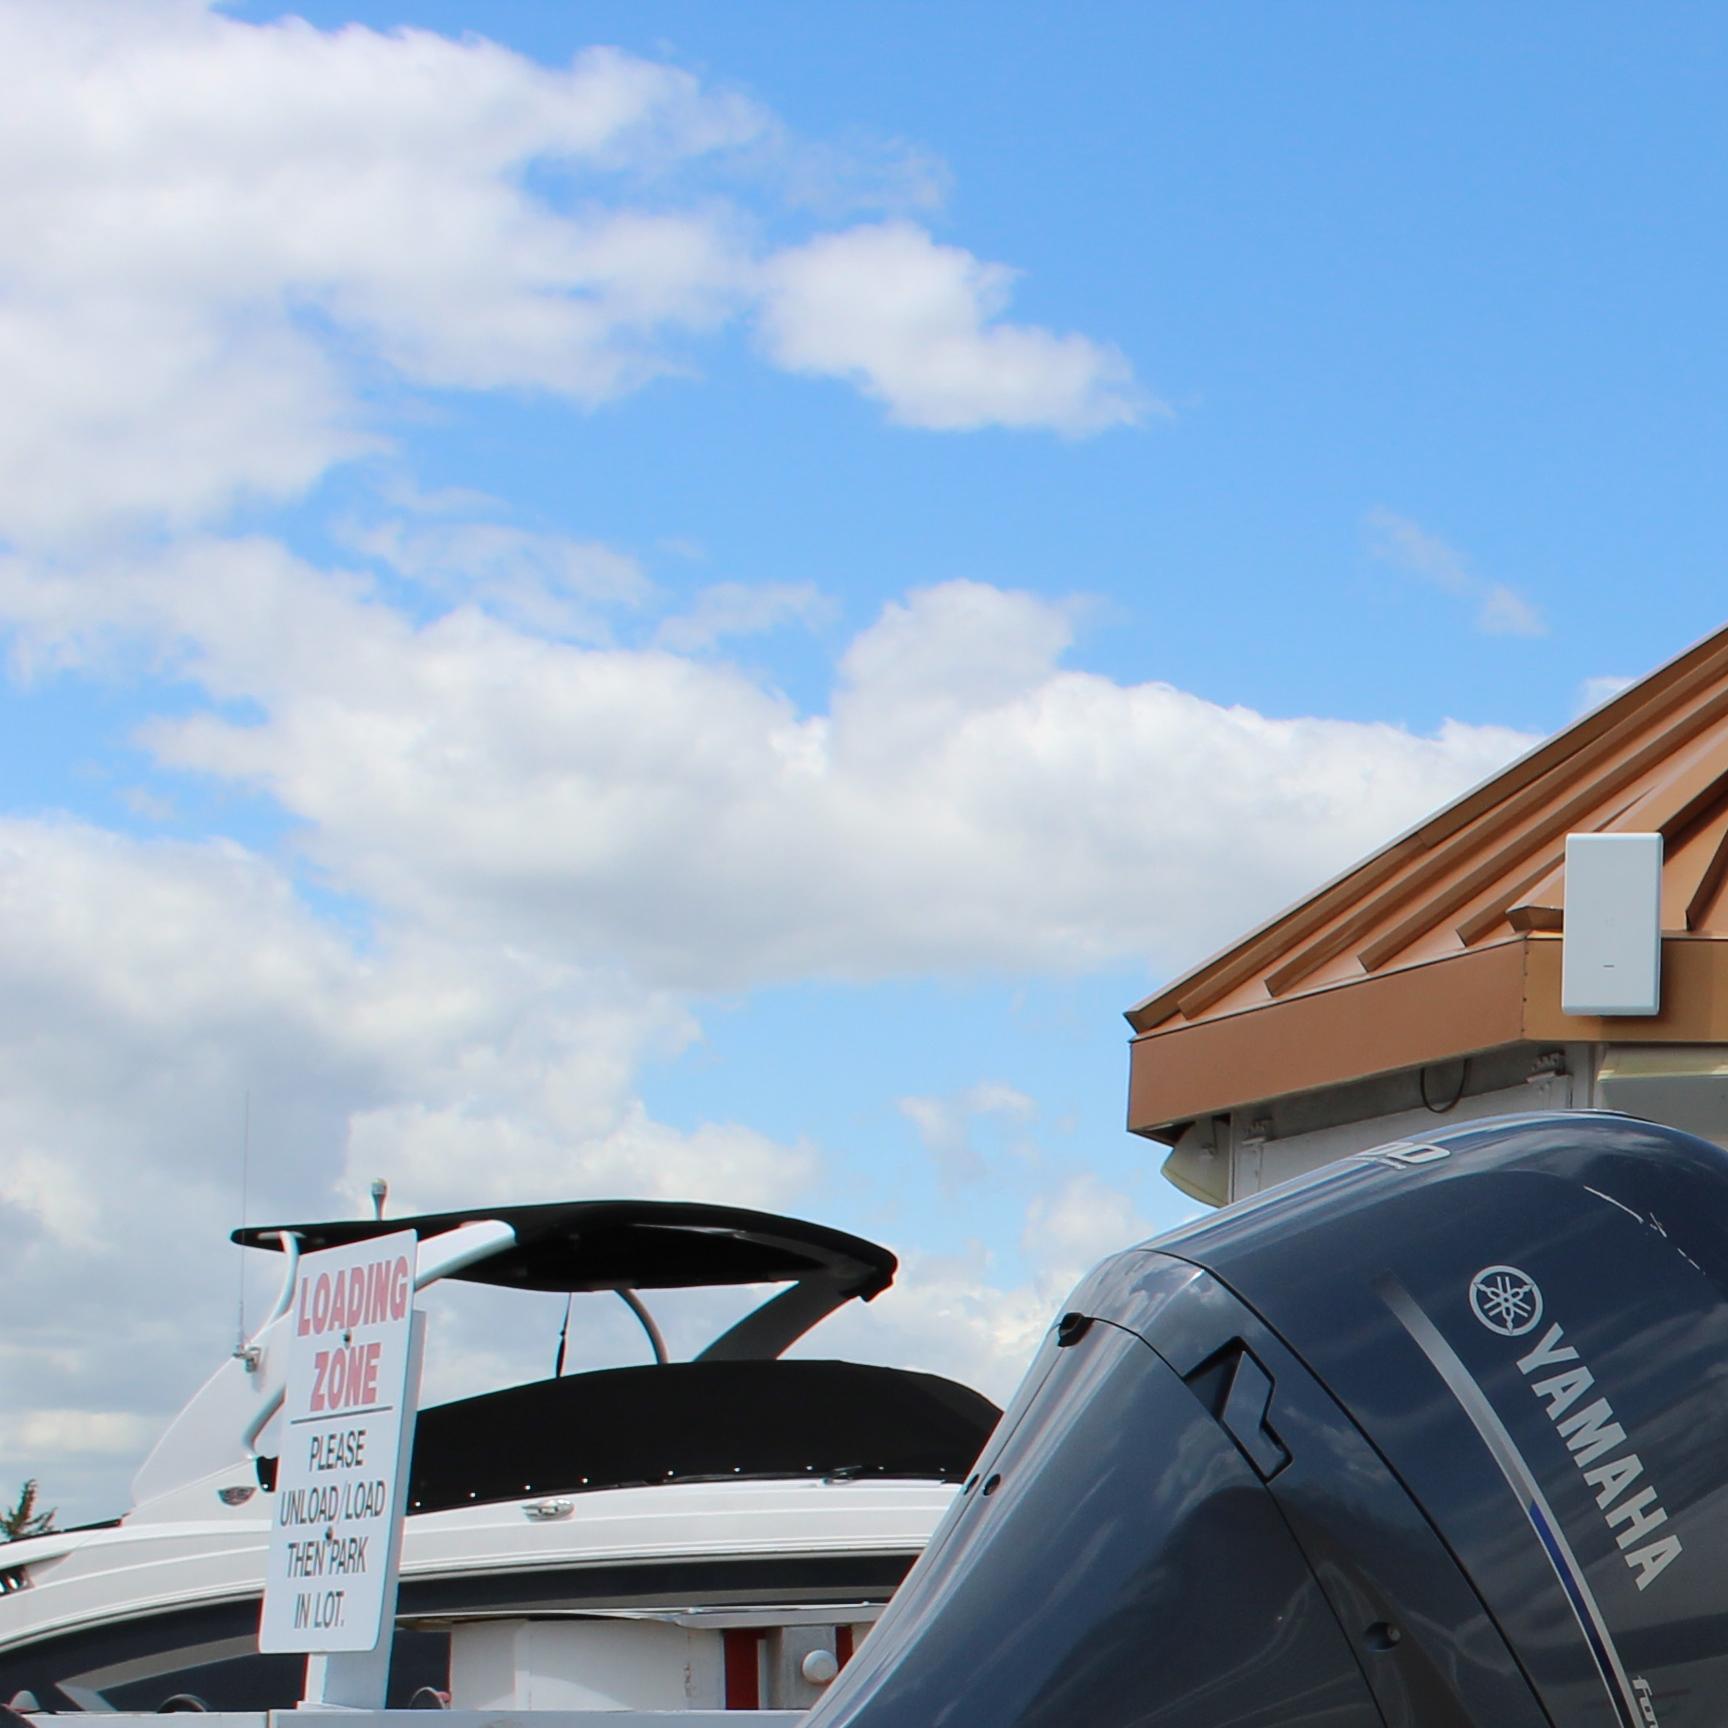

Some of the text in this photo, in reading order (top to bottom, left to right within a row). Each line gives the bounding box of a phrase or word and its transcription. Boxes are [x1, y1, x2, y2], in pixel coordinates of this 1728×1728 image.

[297, 1255, 408, 1337] LOADING
[310, 1342, 382, 1411] ZONE
[309, 1430, 366, 1472] PLEASE
[1516, 1322, 1683, 1591] YAMAHA
[280, 1480, 386, 1527] UNLOAD/LOAD
[287, 1537, 368, 1578] THEN PARK
[294, 1591, 345, 1629] IN LOT.
